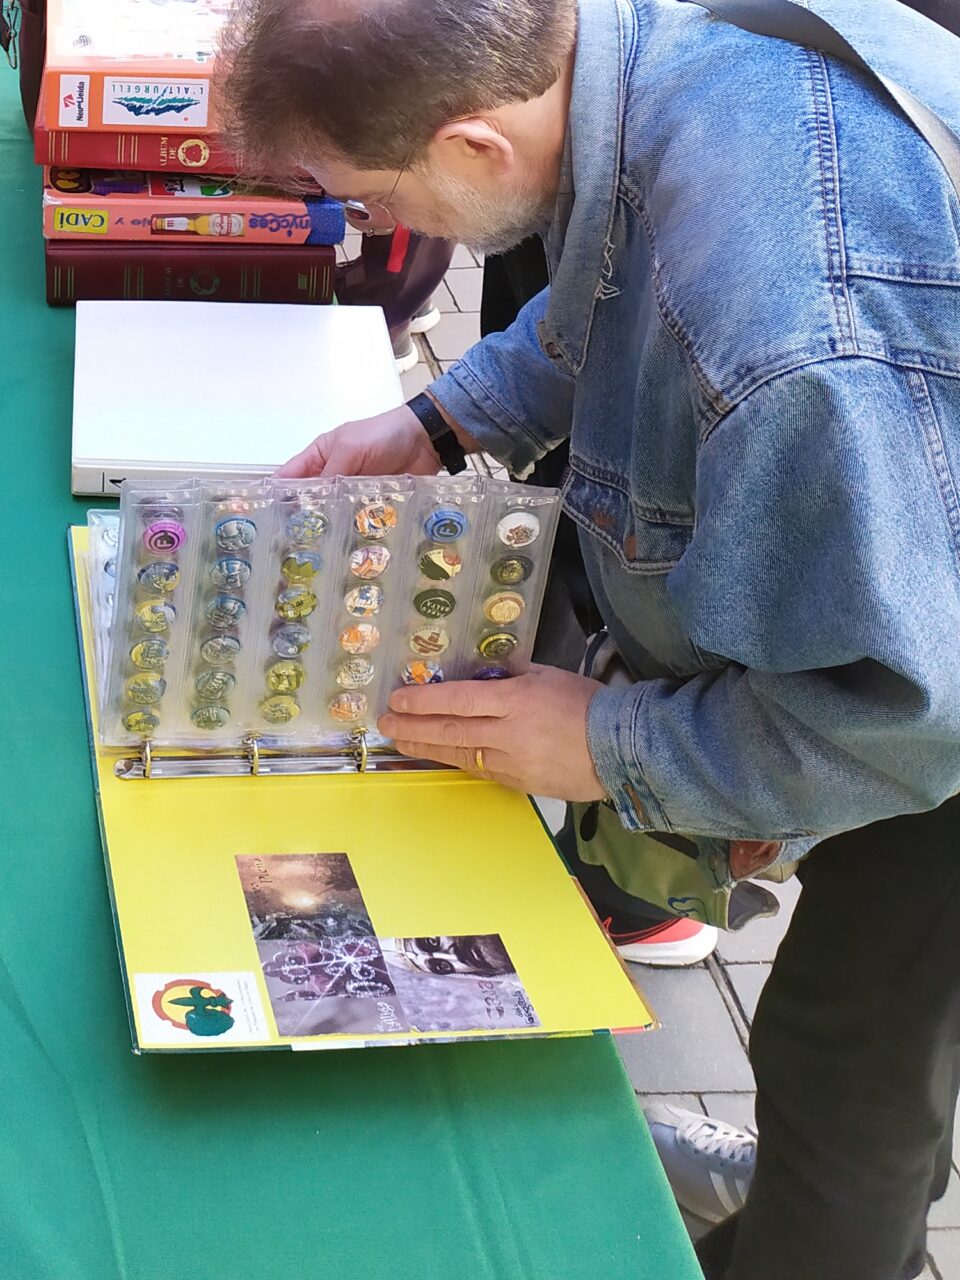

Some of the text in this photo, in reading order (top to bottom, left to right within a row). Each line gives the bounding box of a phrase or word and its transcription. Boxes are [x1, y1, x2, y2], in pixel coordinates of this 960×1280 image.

[112, 84, 159, 94] URGELL
[160, 136, 168, 168] ALBUM
[169, 146, 176, 160] DE
[59, 212, 105, 228] CADÍ
